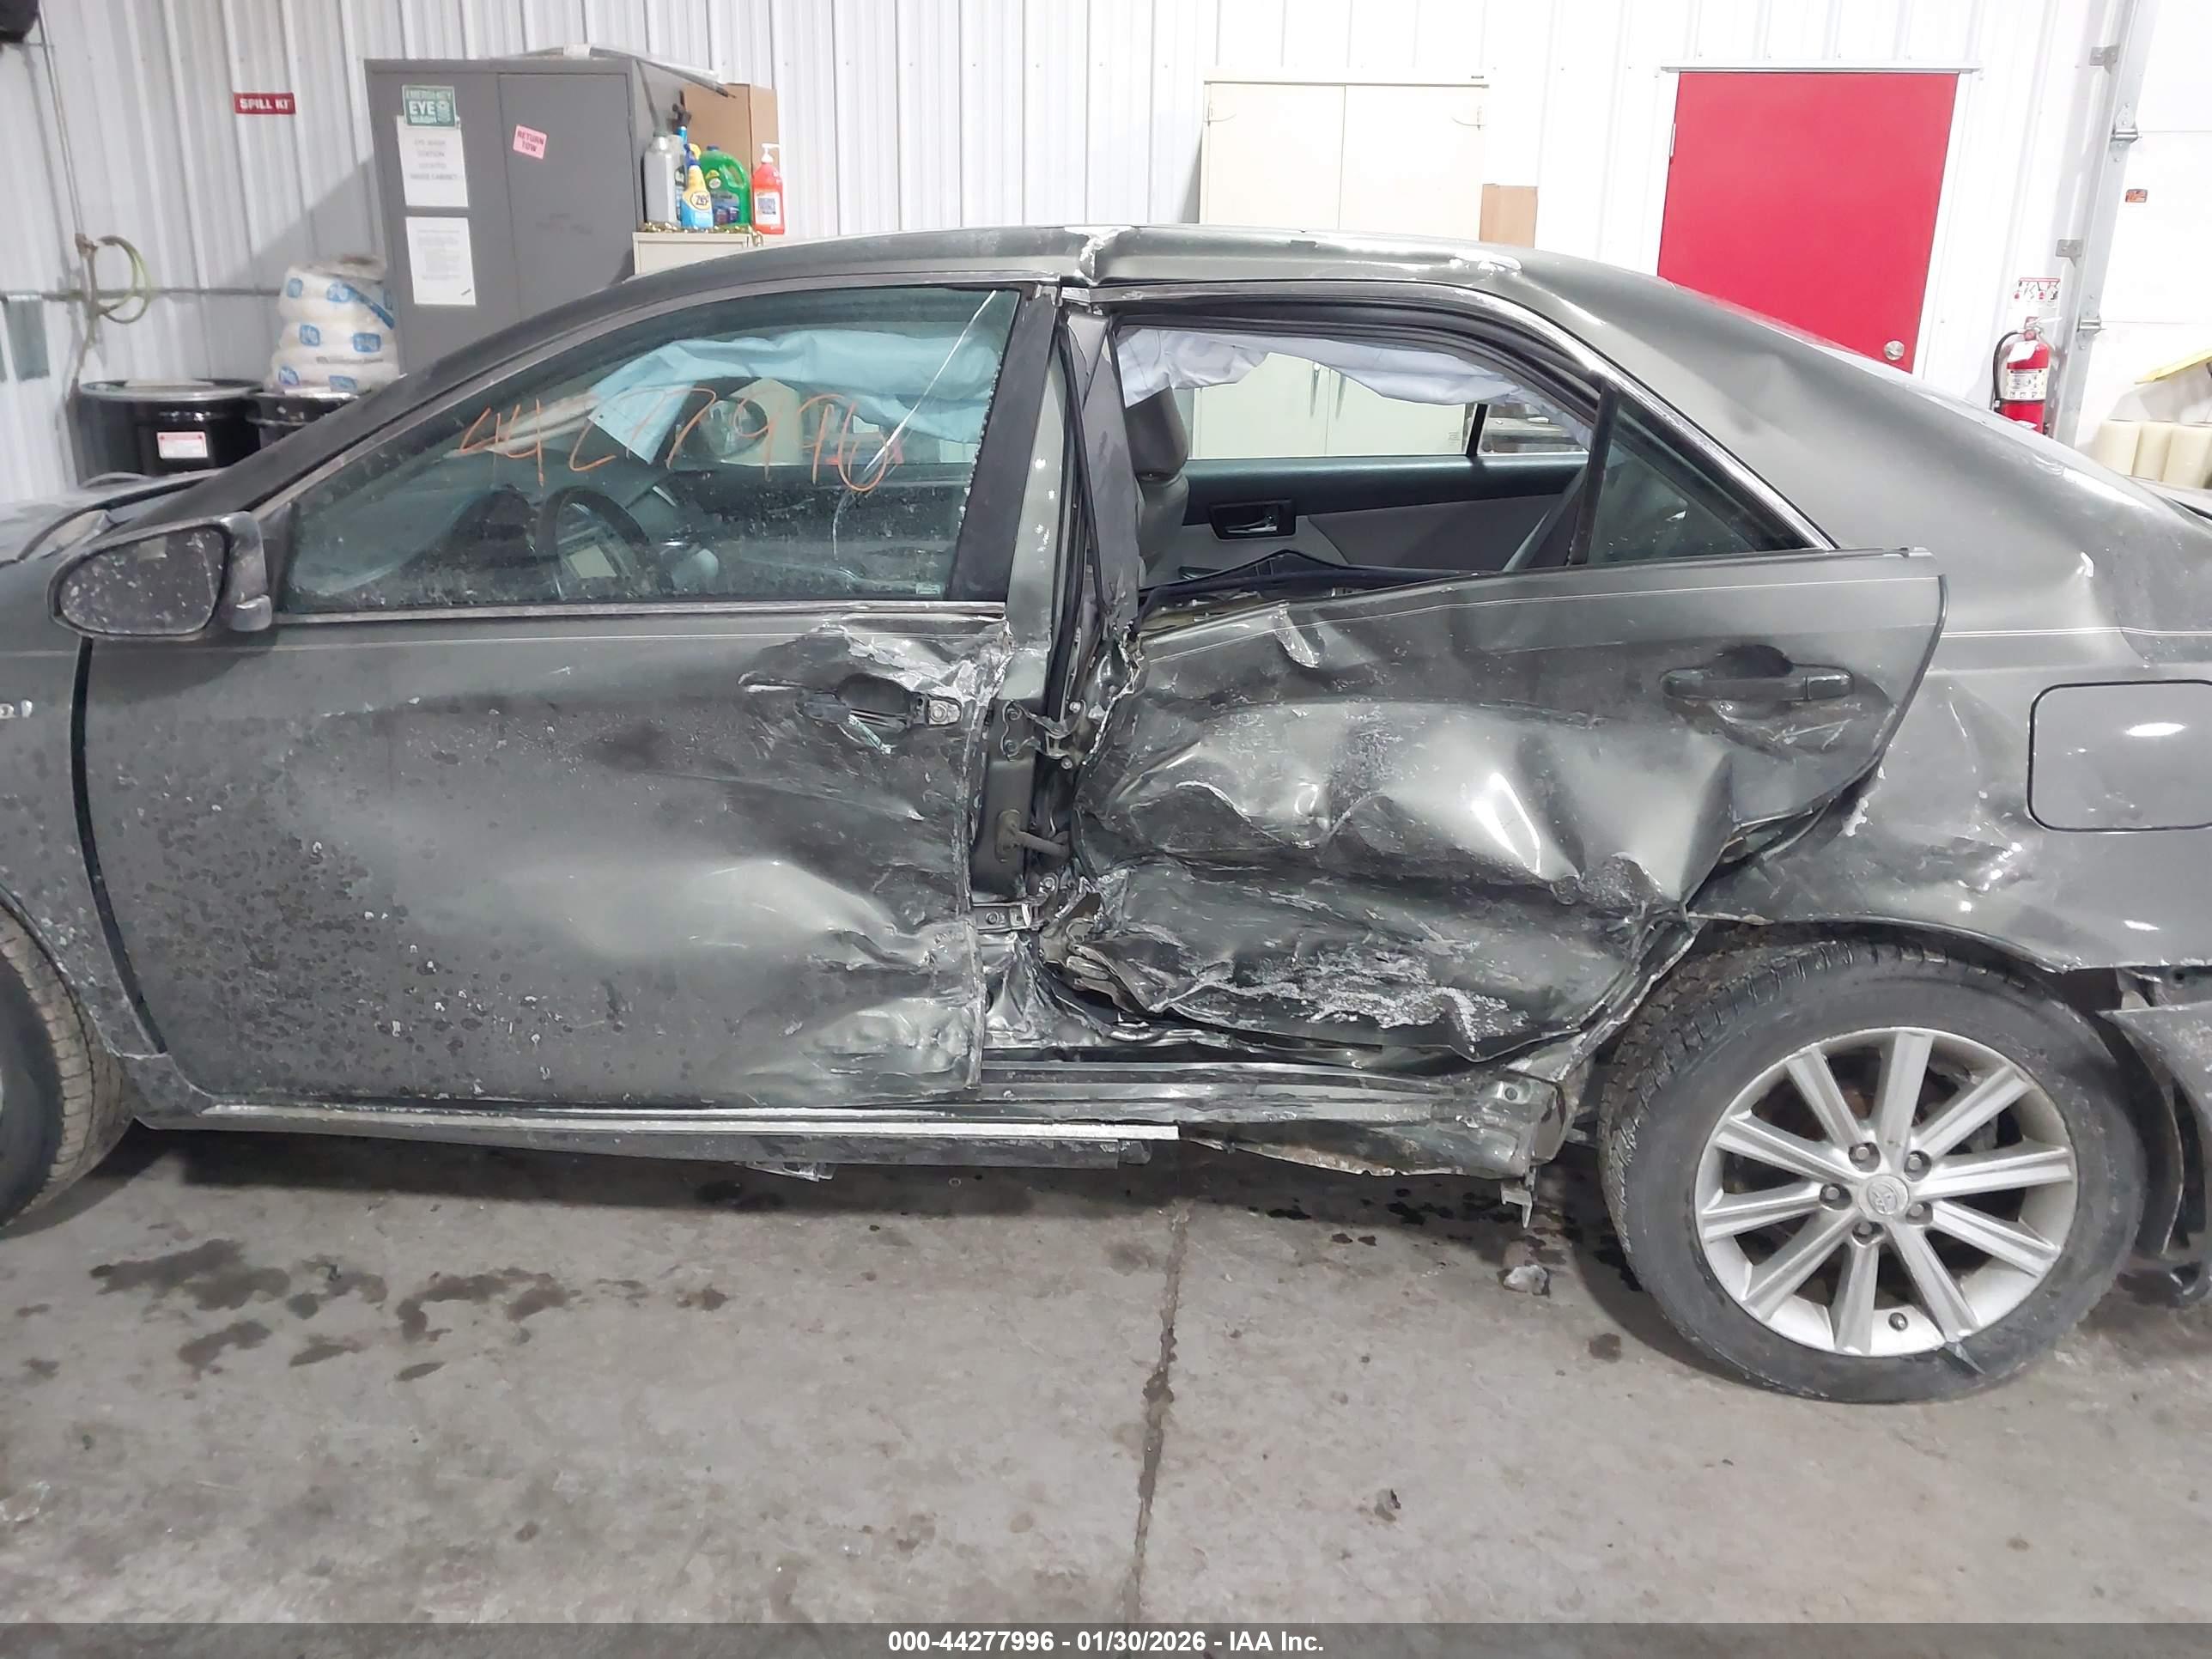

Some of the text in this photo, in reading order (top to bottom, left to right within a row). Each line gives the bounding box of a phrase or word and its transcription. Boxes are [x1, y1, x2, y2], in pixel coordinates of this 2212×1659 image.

[239, 98, 273, 111] SPILL
[408, 101, 435, 115] EYE
[517, 130, 545, 145] RETURN
[521, 140, 538, 152] TOW
